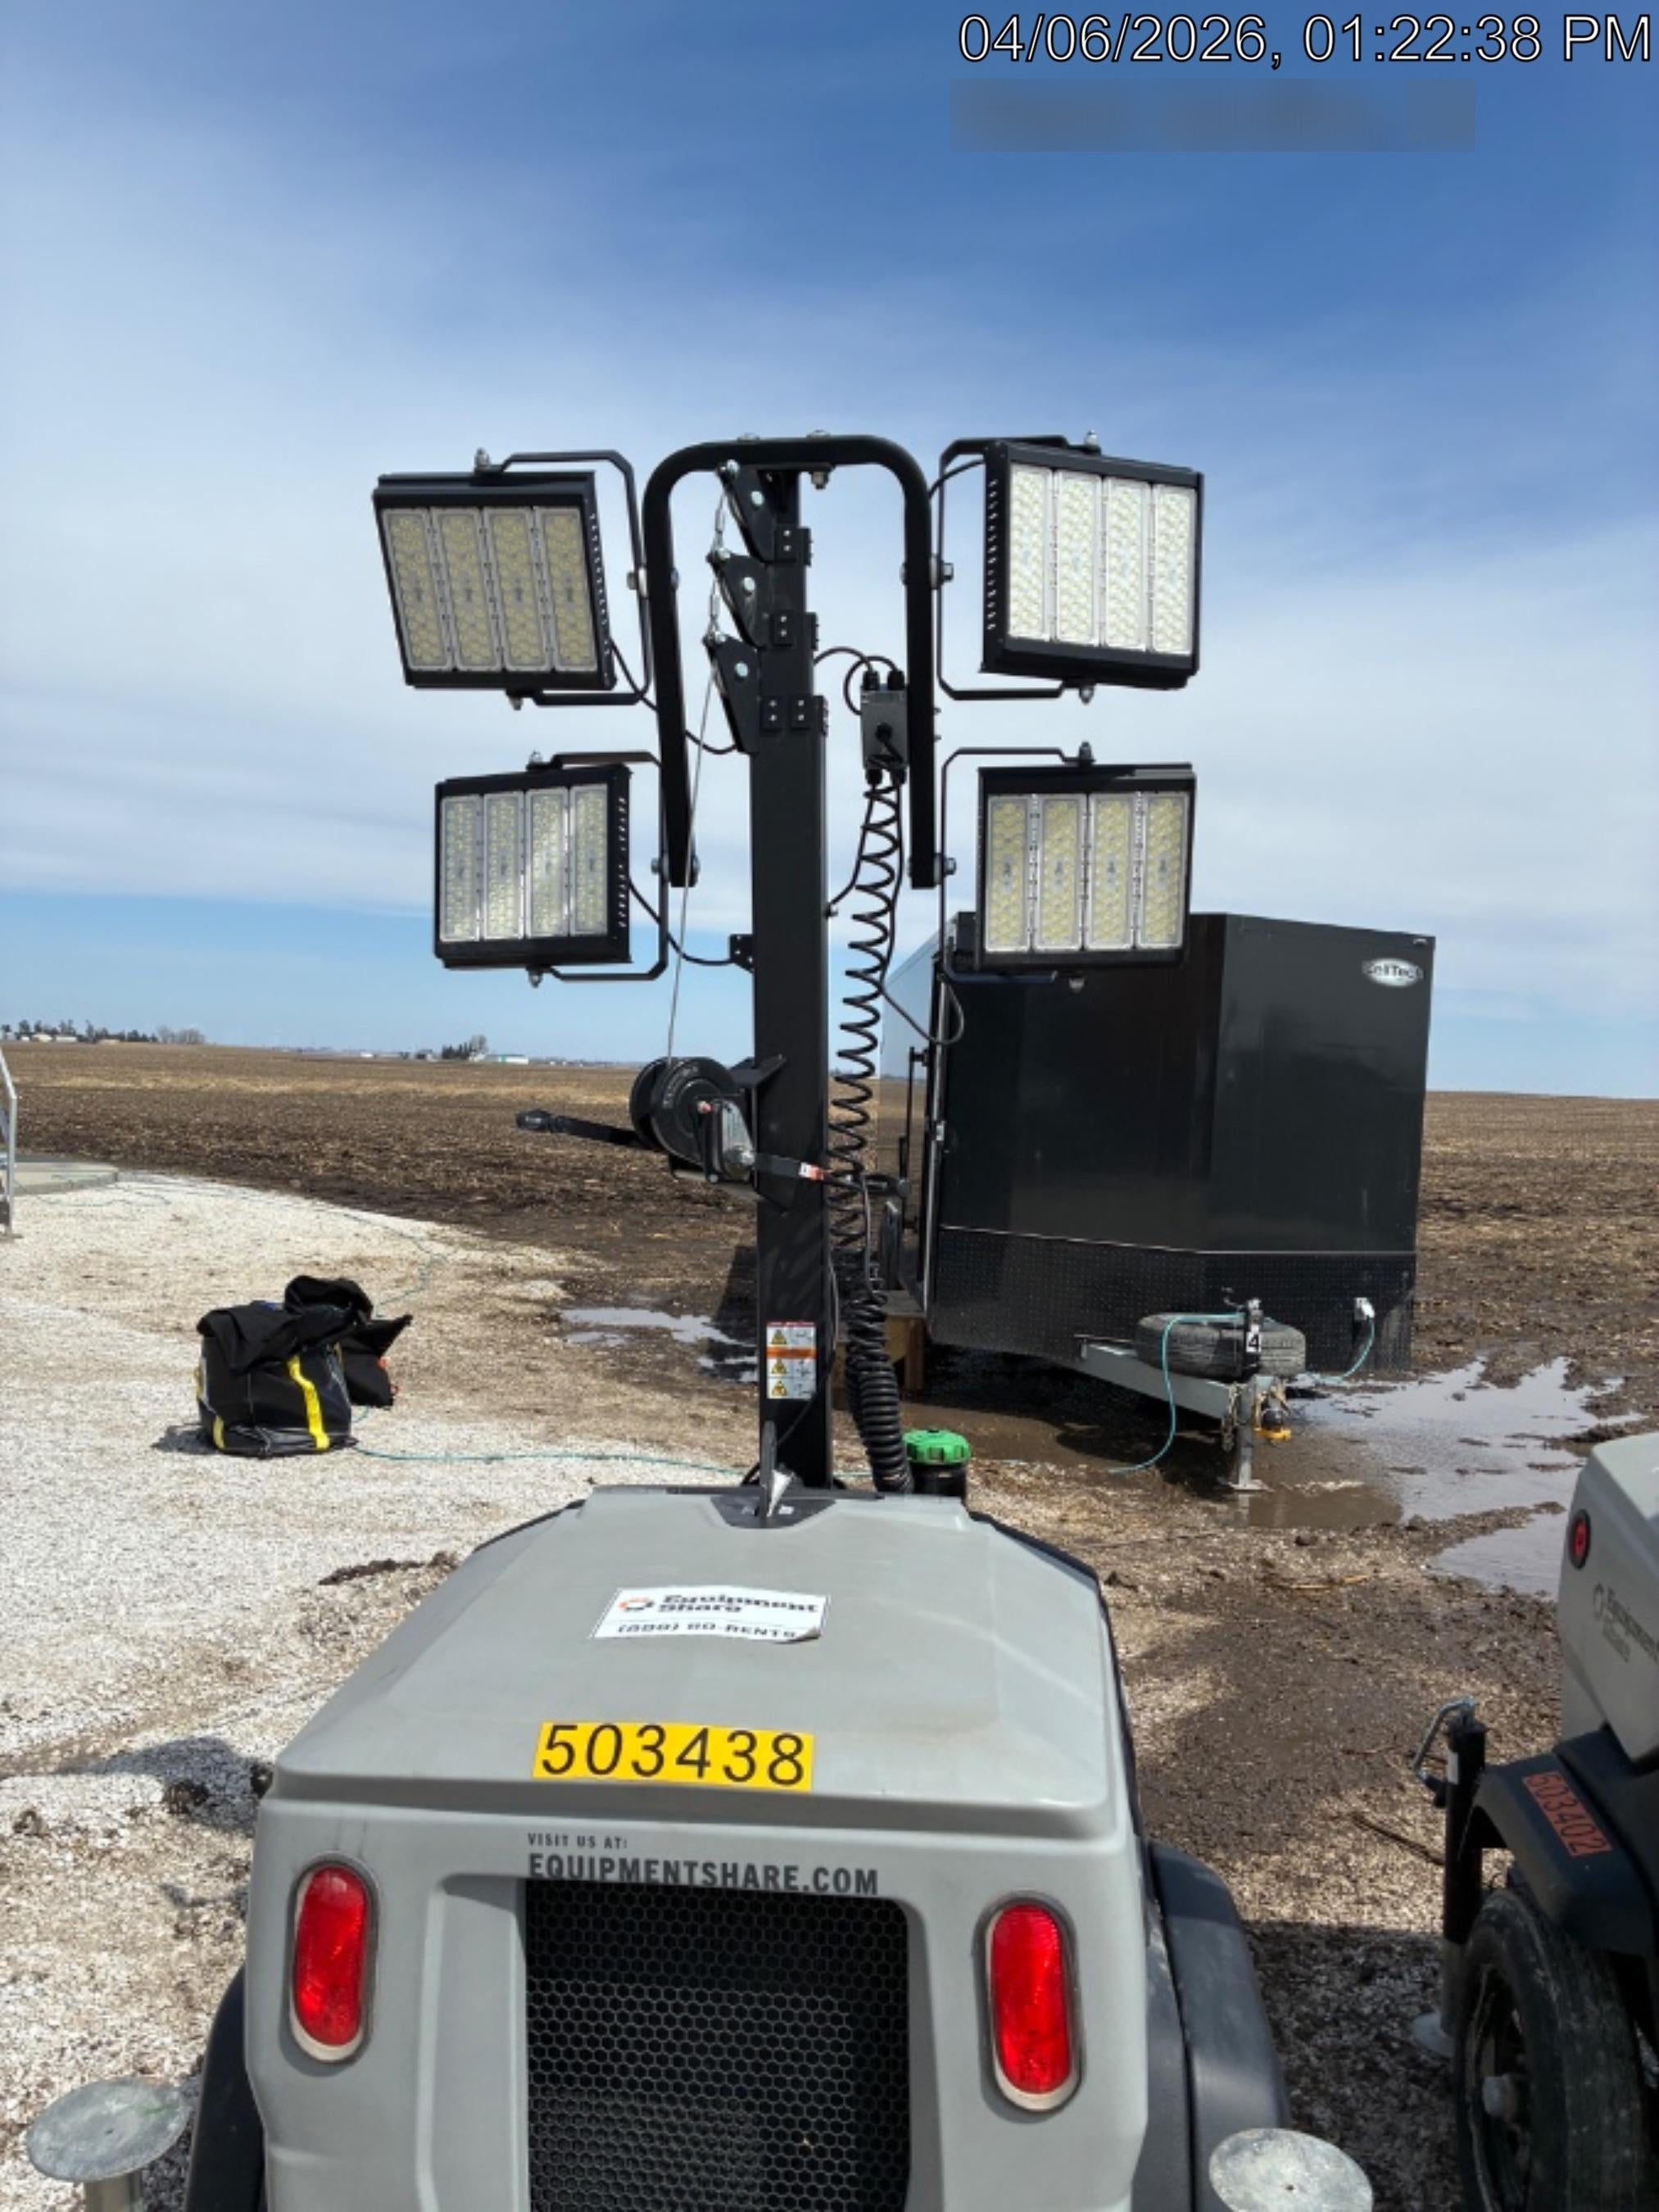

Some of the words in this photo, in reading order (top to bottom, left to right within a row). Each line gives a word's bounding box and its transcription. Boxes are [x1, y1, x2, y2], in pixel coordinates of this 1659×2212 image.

[1247, 1334, 1260, 1351] 4
[658, 1603, 742, 1613] Share
[663, 1593, 817, 1613] Equipment
[542, 1724, 804, 1786] 503438
[528, 1833, 569, 1848] VISIT
[577, 1834, 596, 1848] US
[604, 1836, 628, 1850] AT:
[528, 1852, 878, 1896] EQUIPMENTSHARE.COM
